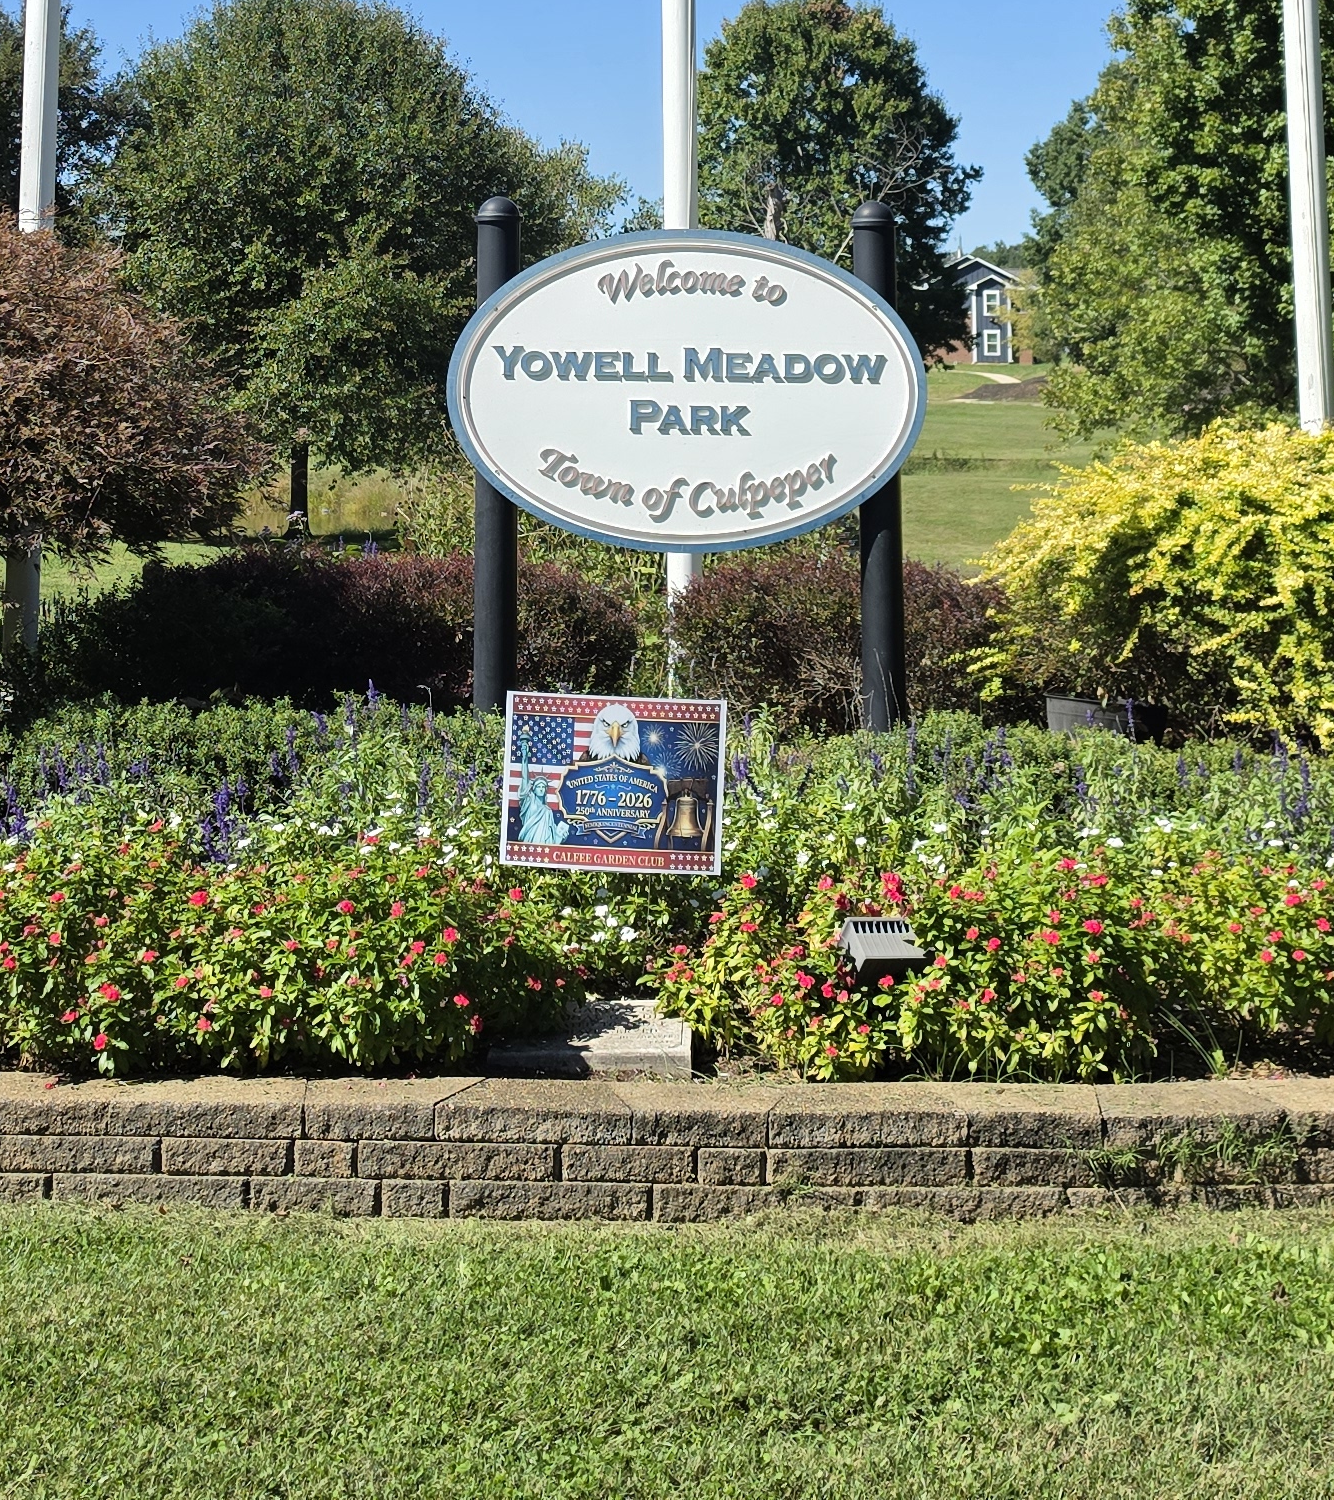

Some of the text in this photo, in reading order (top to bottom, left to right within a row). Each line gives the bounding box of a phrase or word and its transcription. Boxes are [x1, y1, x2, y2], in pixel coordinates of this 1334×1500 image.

[598, 260, 787, 306] Welcome to
[492, 345, 888, 385] YOWELL MEADOW
[629, 400, 752, 437] PARK
[539, 448, 837, 523] Town of Culpeper
[566, 775, 593, 788] UNITED
[619, 774, 628, 782] OF
[629, 777, 658, 793] AMERICA
[575, 790, 606, 805] 1776
[618, 792, 653, 807] 2026
[575, 806, 650, 818] 250th ANNIVERSARY
[552, 851, 665, 866] CALFEE GARDEN CLUB
